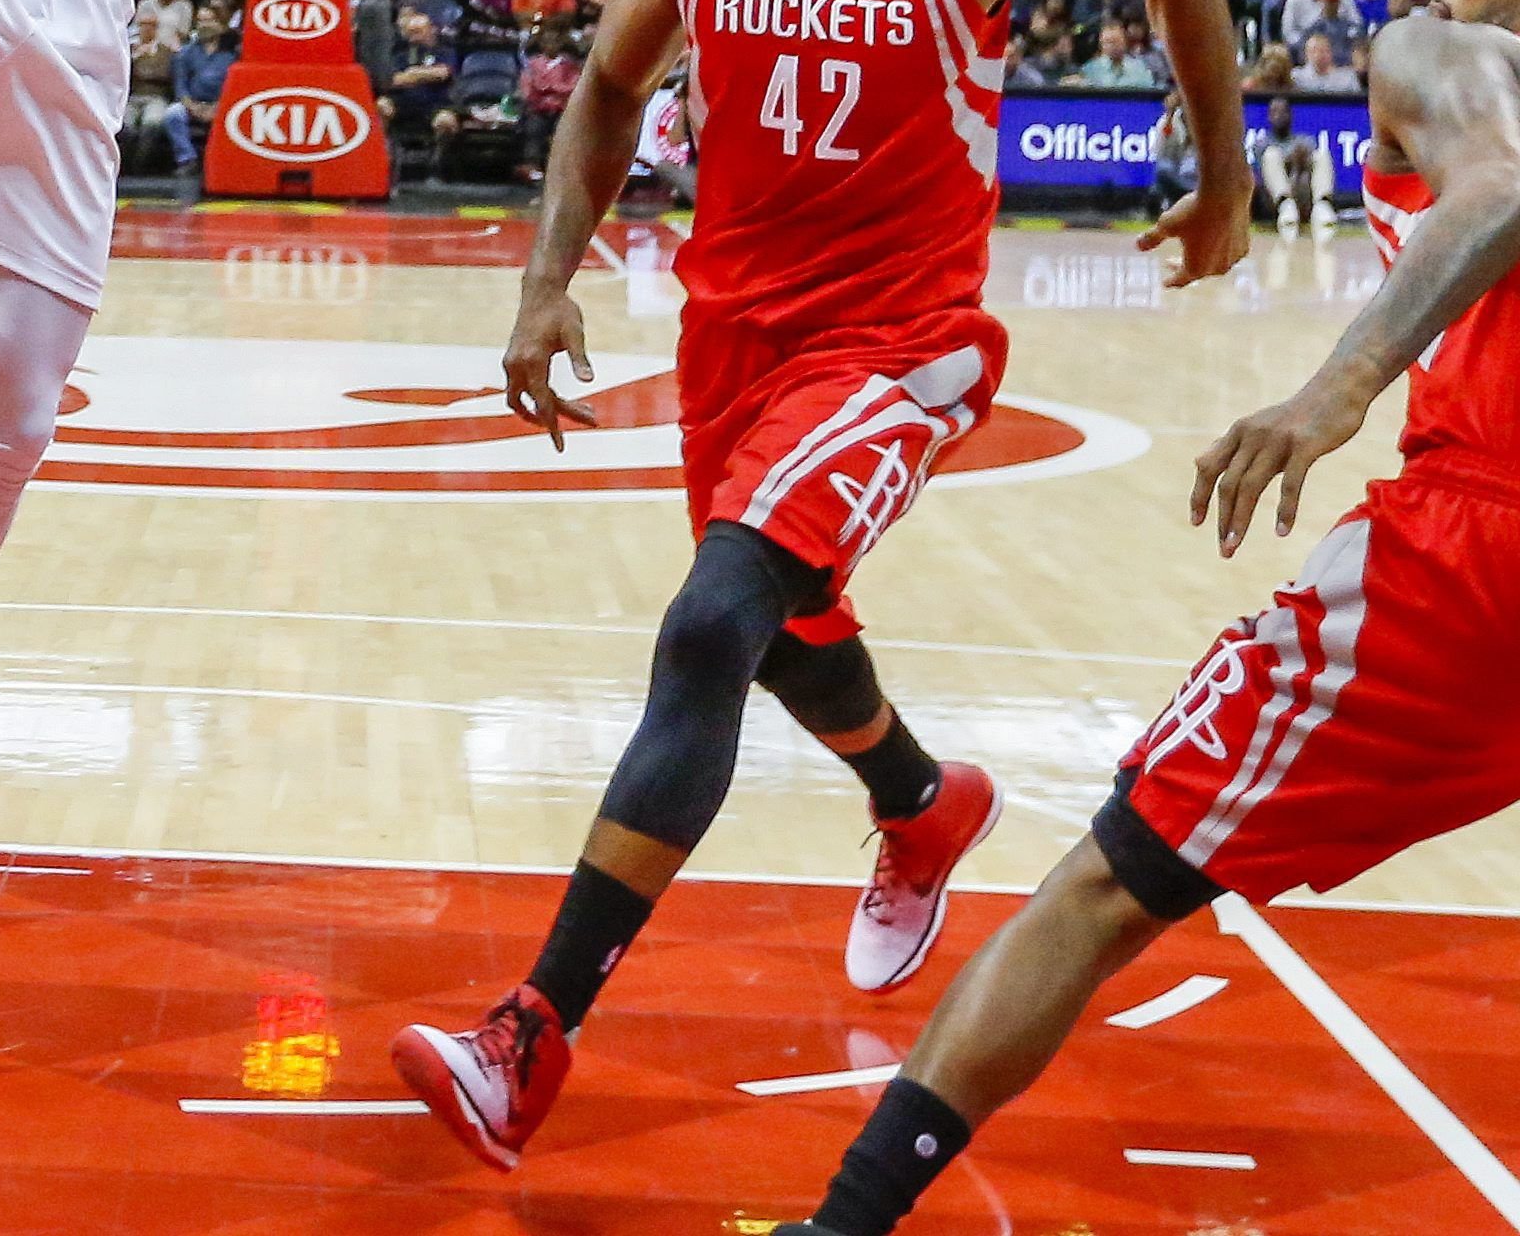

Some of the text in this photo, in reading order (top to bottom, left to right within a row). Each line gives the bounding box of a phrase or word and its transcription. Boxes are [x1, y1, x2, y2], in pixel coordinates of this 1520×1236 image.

[265, 3, 327, 30] KIA
[249, 104, 346, 146] KIA
[760, 54, 862, 161] 42
[1020, 124, 1157, 162] Official
